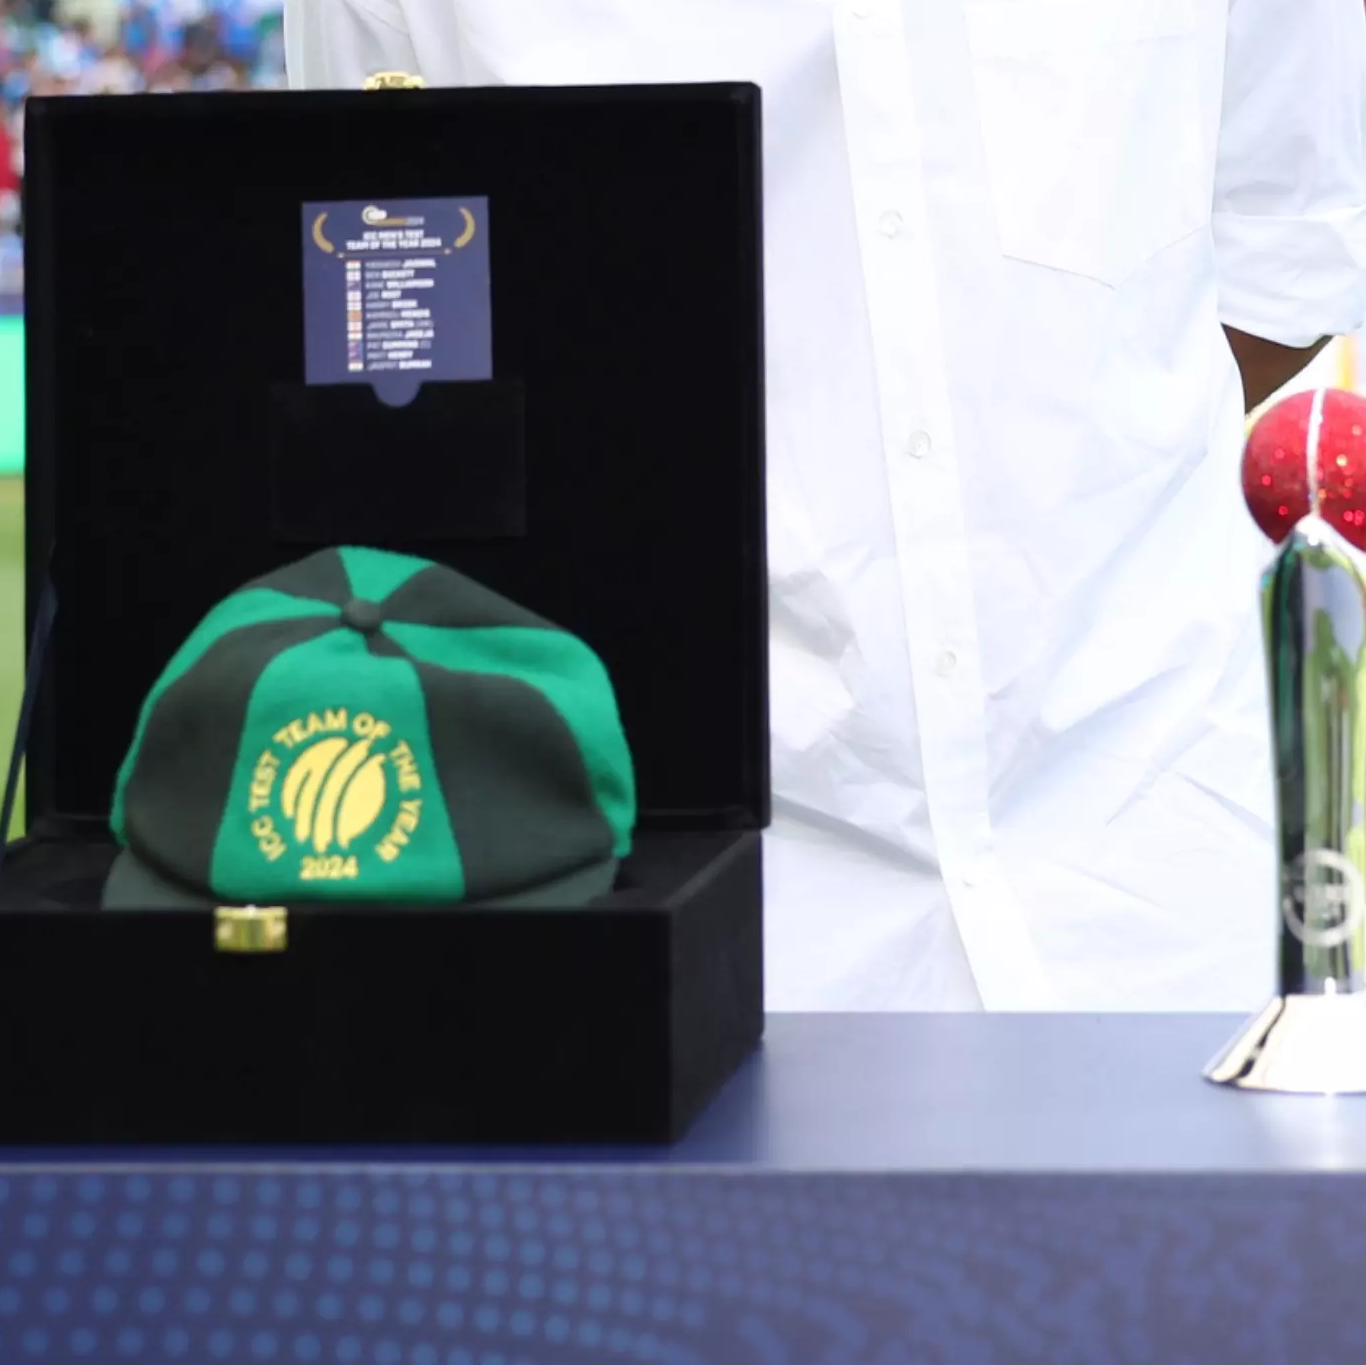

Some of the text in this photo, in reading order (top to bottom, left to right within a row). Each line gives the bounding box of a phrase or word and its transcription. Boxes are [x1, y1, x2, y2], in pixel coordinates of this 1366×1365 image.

[248, 707, 423, 865] ICC TEST TEAM OF THE YEAR
[299, 855, 359, 882] 2024
